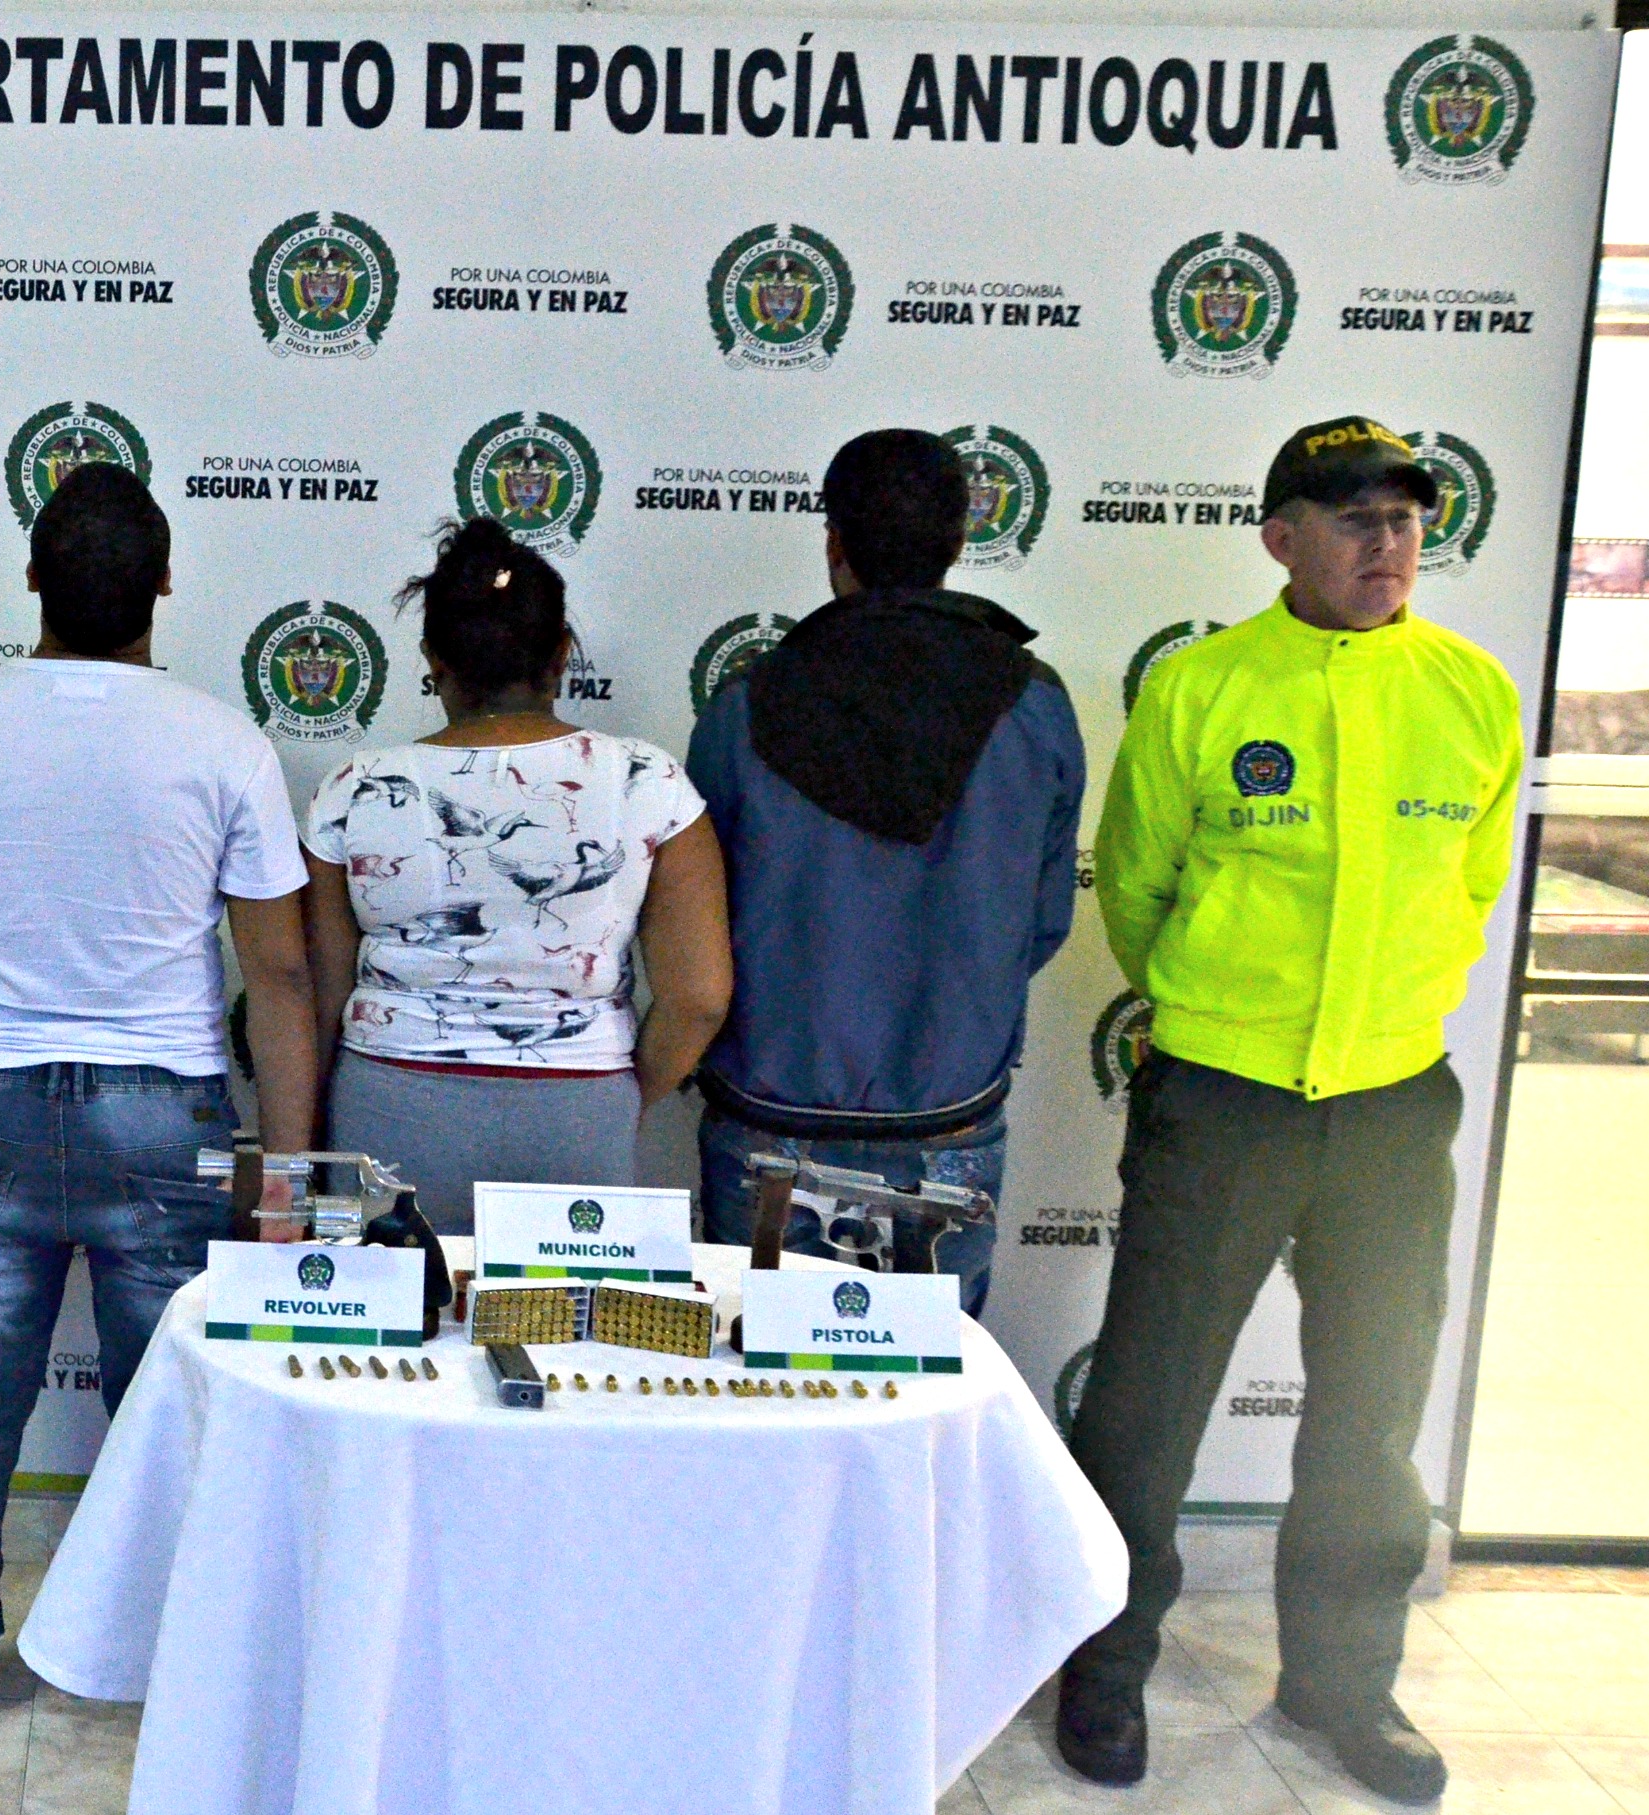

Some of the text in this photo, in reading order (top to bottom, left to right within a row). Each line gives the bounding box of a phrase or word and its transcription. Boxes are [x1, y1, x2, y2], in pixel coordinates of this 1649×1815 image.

[425, 42, 524, 131] DE
[555, 32, 869, 139] POLICÍA
[893, 53, 1338, 154] ANTIOQUIA
[33, 260, 68, 273] UNA
[72, 260, 155, 274] COLOMBIA
[347, 235, 379, 293] COLOMBIA
[452, 268, 610, 284] POR UNA COLOMBIA
[73, 280, 87, 301] Y
[95, 281, 121, 302] EN
[130, 281, 173, 303] PAZ
[433, 287, 628, 313] SEGURA Y EN PAZ
[908, 281, 1063, 298] POR UNA COLOMBIA
[1361, 288, 1517, 304] POR UNA COLOMBIA
[324, 308, 374, 340] NACIONAL
[888, 301, 1081, 327] SEGURA Y EN PAZ
[1341, 307, 1533, 333] SEGURA Y EN PAZ
[323, 340, 360, 355] PATRIA
[204, 457, 361, 473] POR UNA COLOMBIA
[654, 468, 810, 484] POR UNA COLOMBIA
[186, 476, 378, 501] SEGURA Y EN PAZ
[1102, 482, 1254, 497] POR UNA COLOMBIA
[636, 487, 825, 513] SEGURA Y EN PAZ
[1083, 500, 1166, 523] SEGURA
[1175, 503, 1188, 524] Y
[1195, 503, 1221, 524] EN
[338, 624, 369, 680] COLOMBIA
[569, 678, 613, 700] PAZ
[314, 693, 363, 725] NACIONAL
[314, 725, 350, 738] PATRIA
[1229, 804, 1309, 827] DIJIN
[1020, 1225, 1099, 1246] SEGURA
[539, 1242, 635, 1258] MUNICIÓN
[264, 1300, 366, 1316] REVOLVER
[811, 1329, 895, 1344] PISTOLA
[54, 1370, 68, 1389] Y
